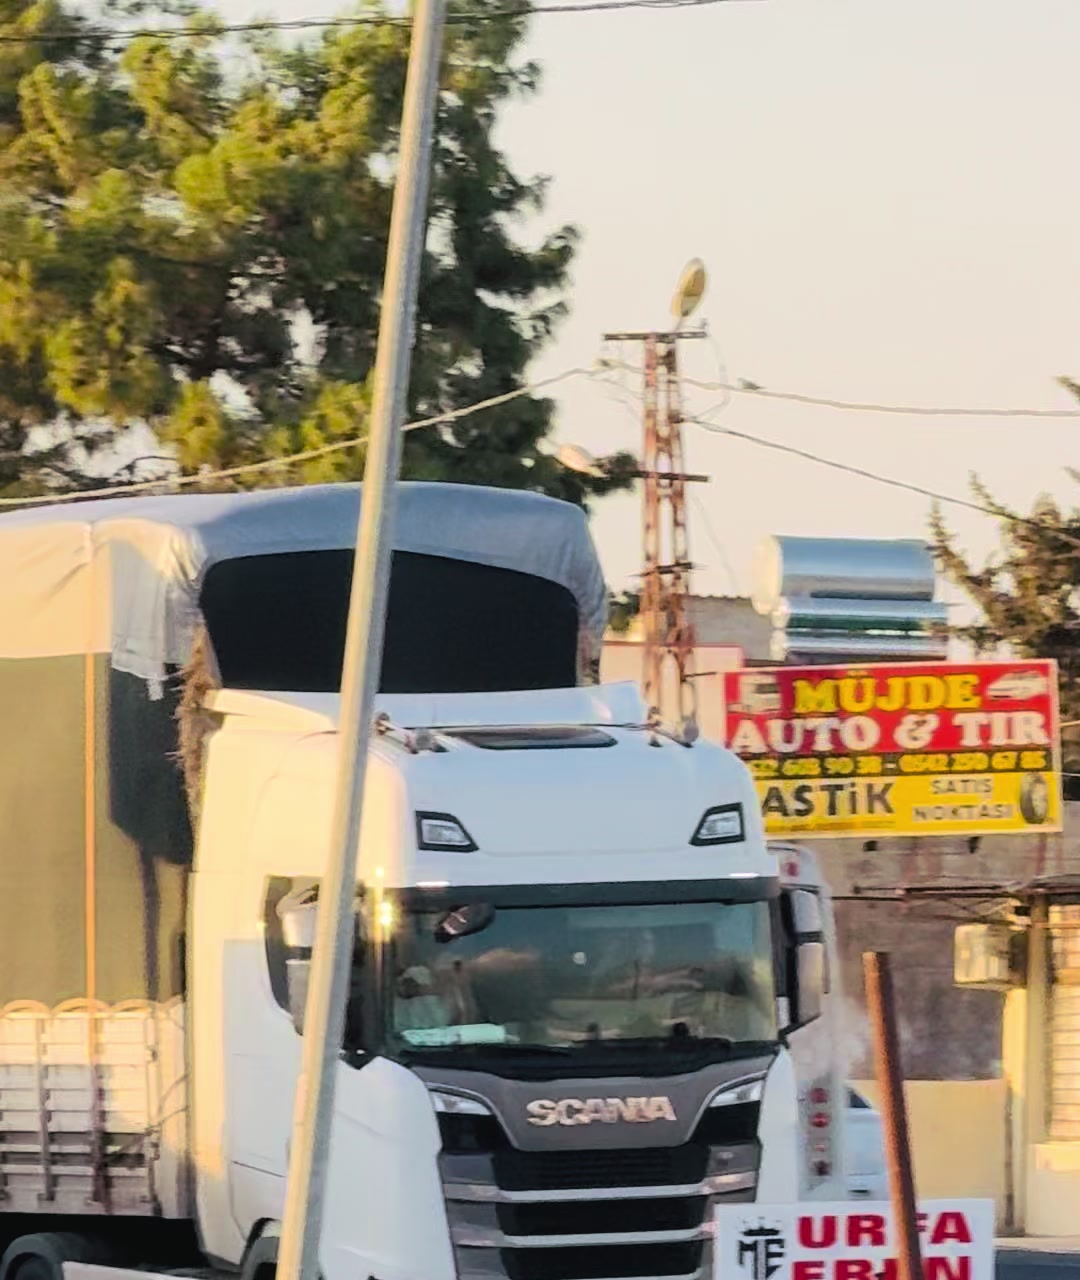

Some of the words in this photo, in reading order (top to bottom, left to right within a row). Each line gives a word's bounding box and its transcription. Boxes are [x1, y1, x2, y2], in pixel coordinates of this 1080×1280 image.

[791, 669, 981, 714] MÜJDE
[731, 715, 881, 754] AUTO
[893, 713, 941, 750] &
[953, 710, 1051, 748] TIR
[761, 781, 895, 818] ASTiK
[526, 1095, 678, 1126] SCANIA
